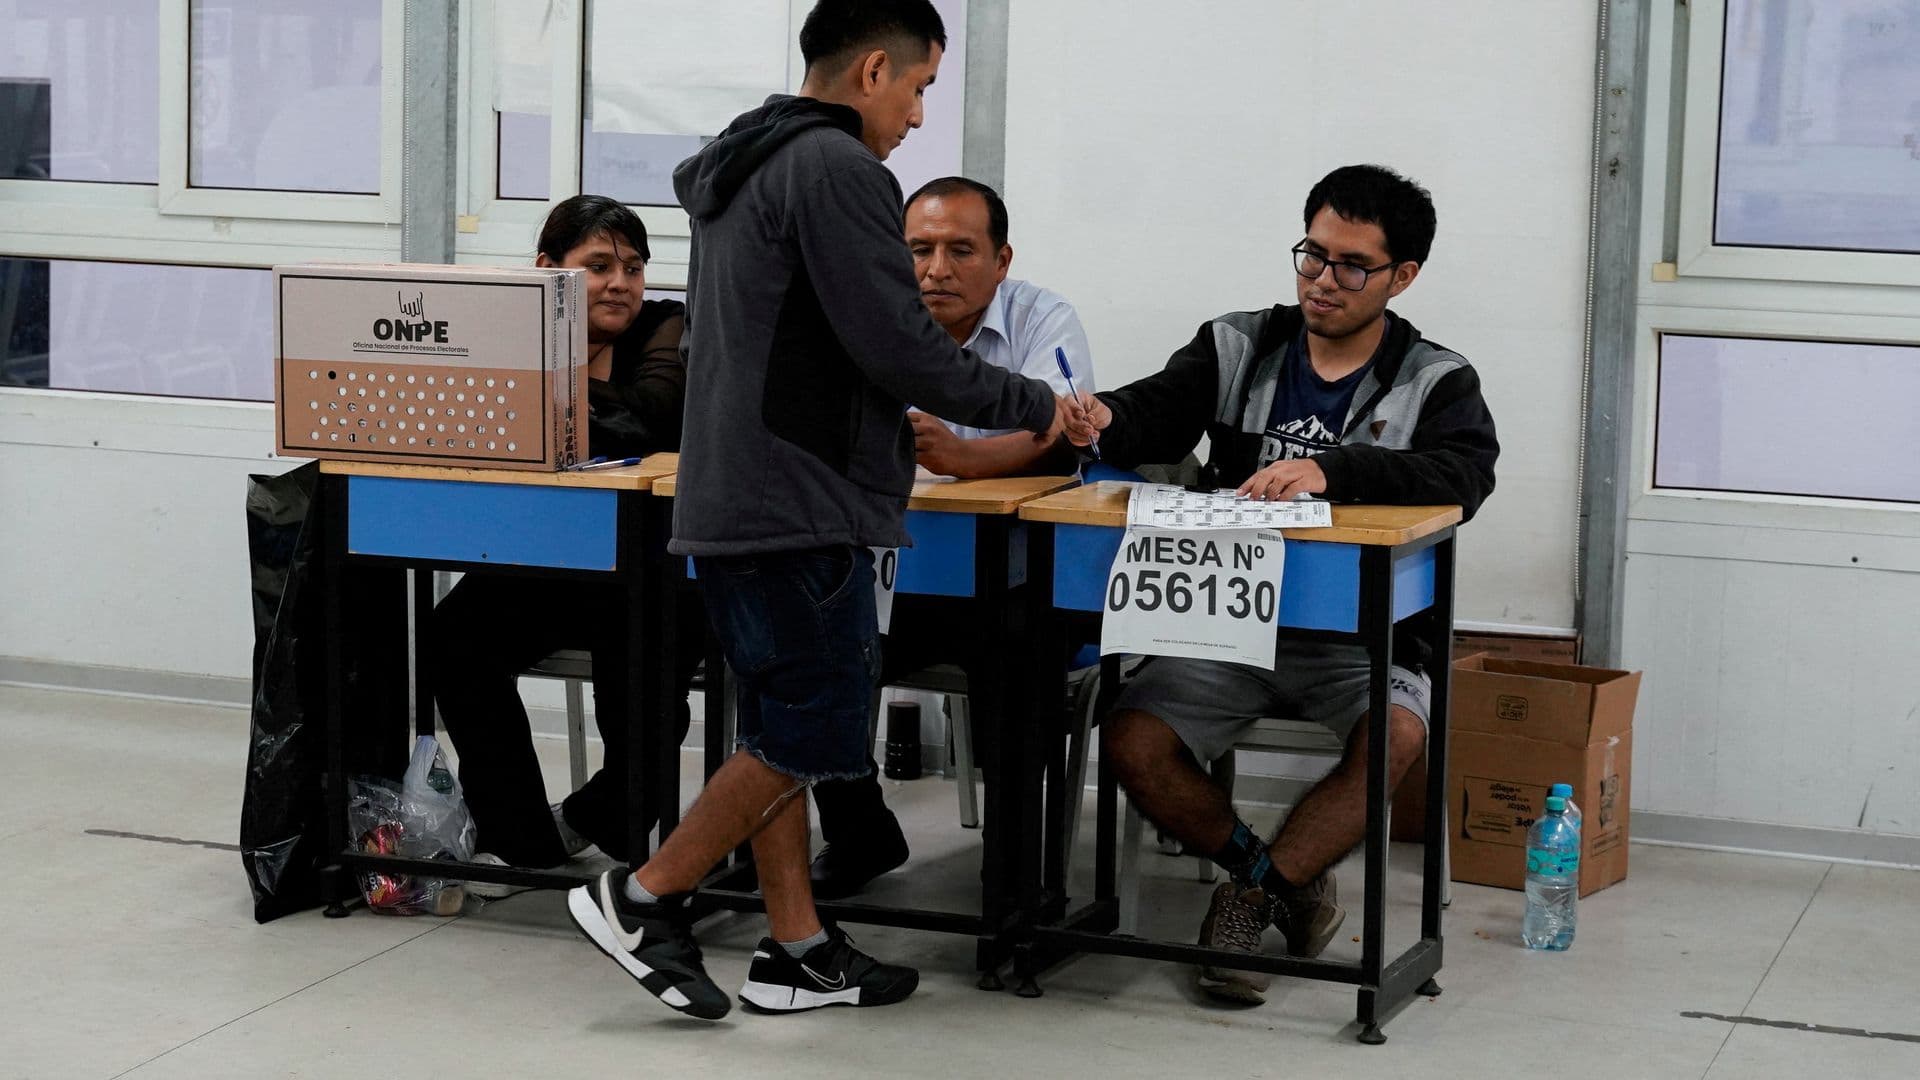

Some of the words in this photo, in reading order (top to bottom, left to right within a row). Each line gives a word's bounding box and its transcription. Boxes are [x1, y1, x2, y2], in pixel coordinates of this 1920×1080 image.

[373, 318, 449, 344] ONPE
[410, 344, 436, 352] Procesos
[437, 345, 469, 353] Electorales
[1126, 536, 1223, 568] MESA
[1108, 570, 1275, 624] 056130
